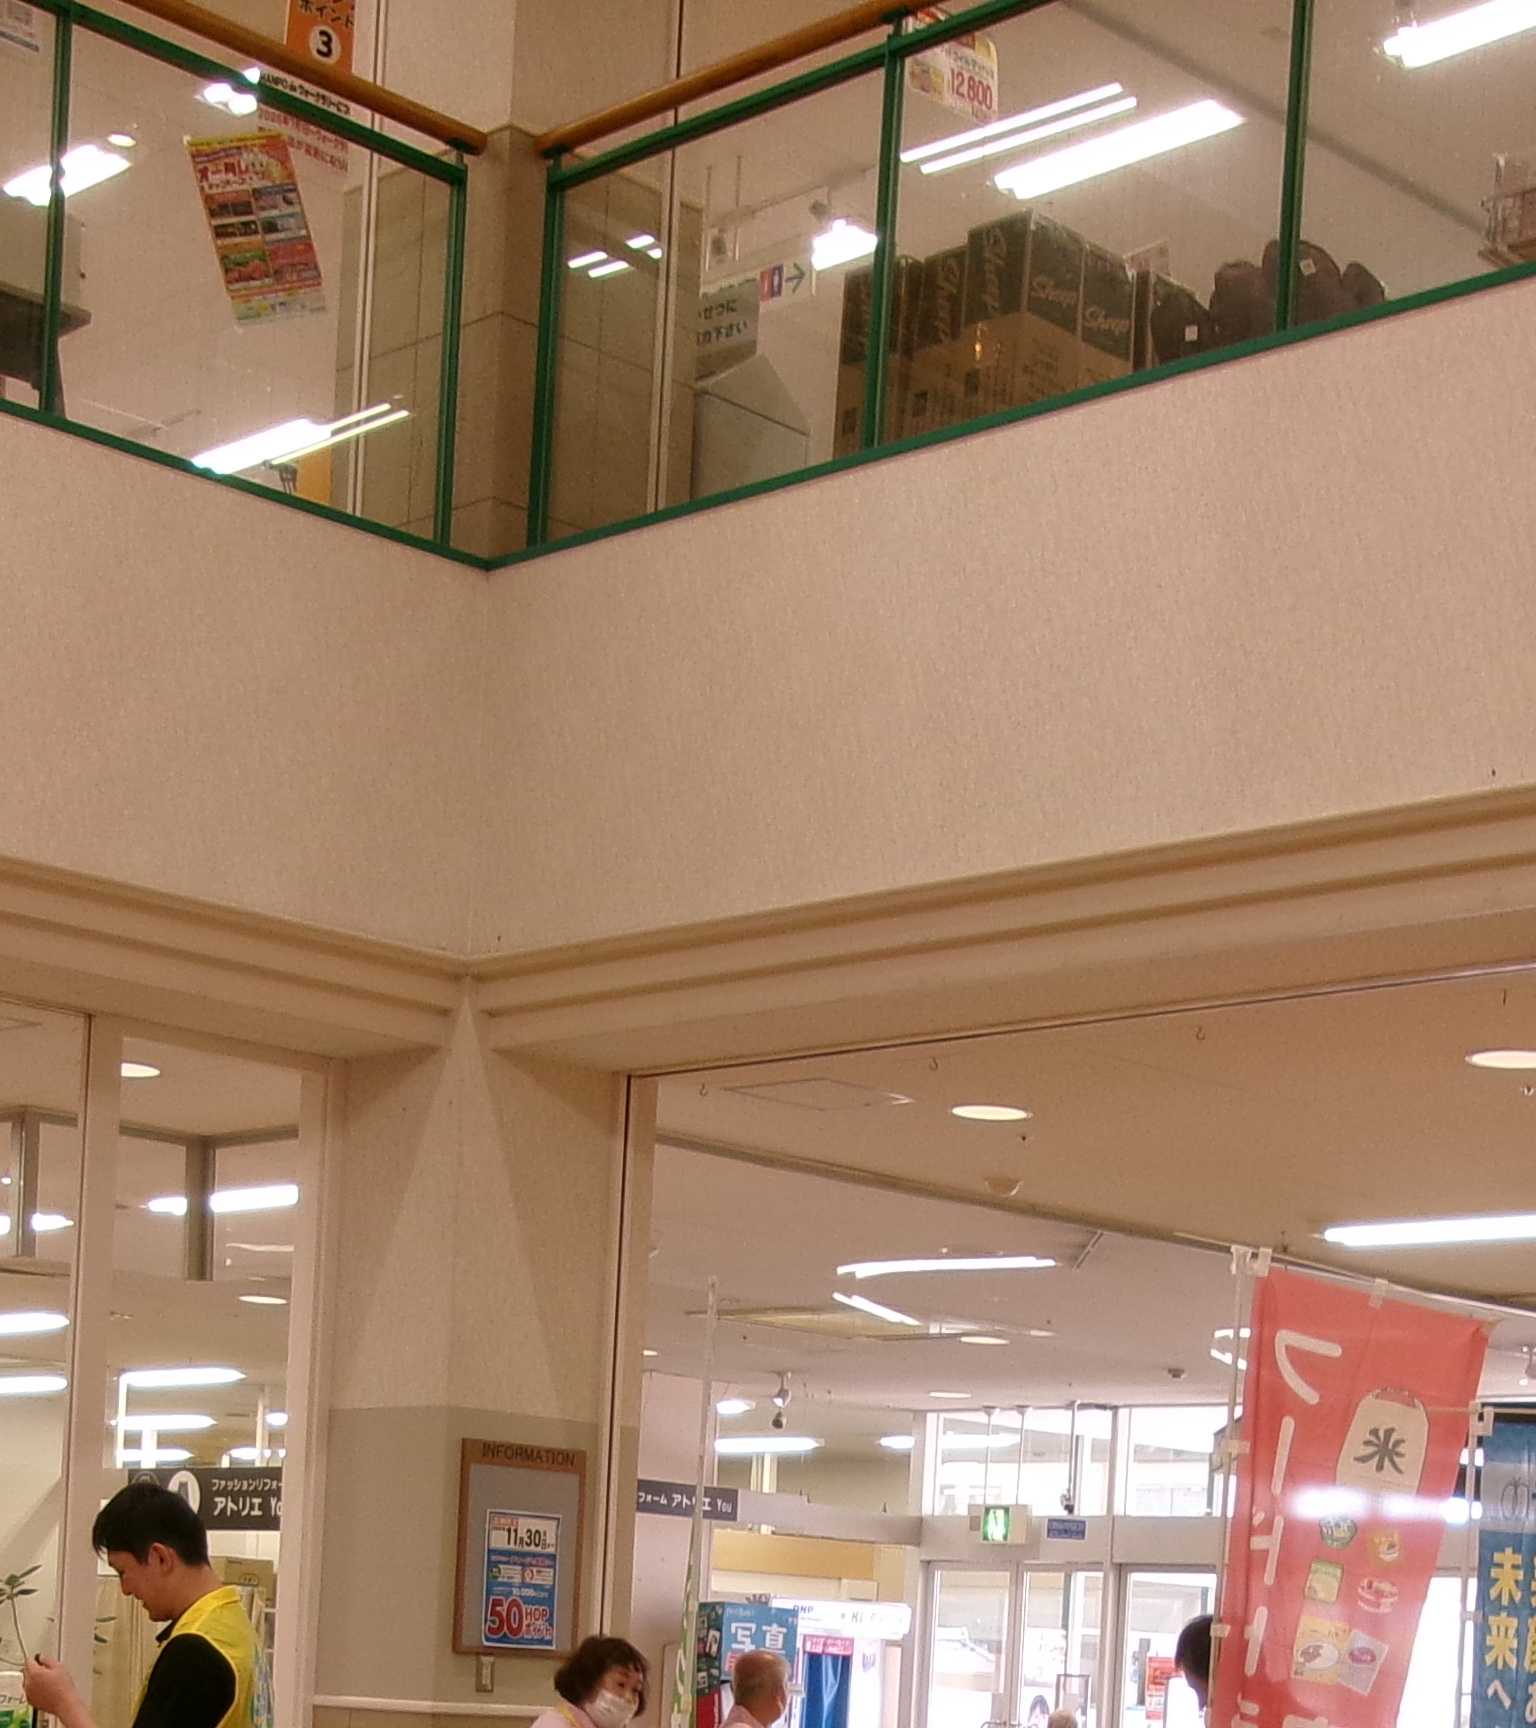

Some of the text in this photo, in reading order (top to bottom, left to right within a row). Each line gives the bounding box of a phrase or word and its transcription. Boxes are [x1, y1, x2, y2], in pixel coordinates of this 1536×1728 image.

[316, 29, 334, 58] 3
[481, 1442, 576, 1467] INFORMATION
[213, 1496, 263, 1517] アトリエ
[716, 1497, 733, 1514] You
[485, 1596, 550, 1640] 50 HOP
